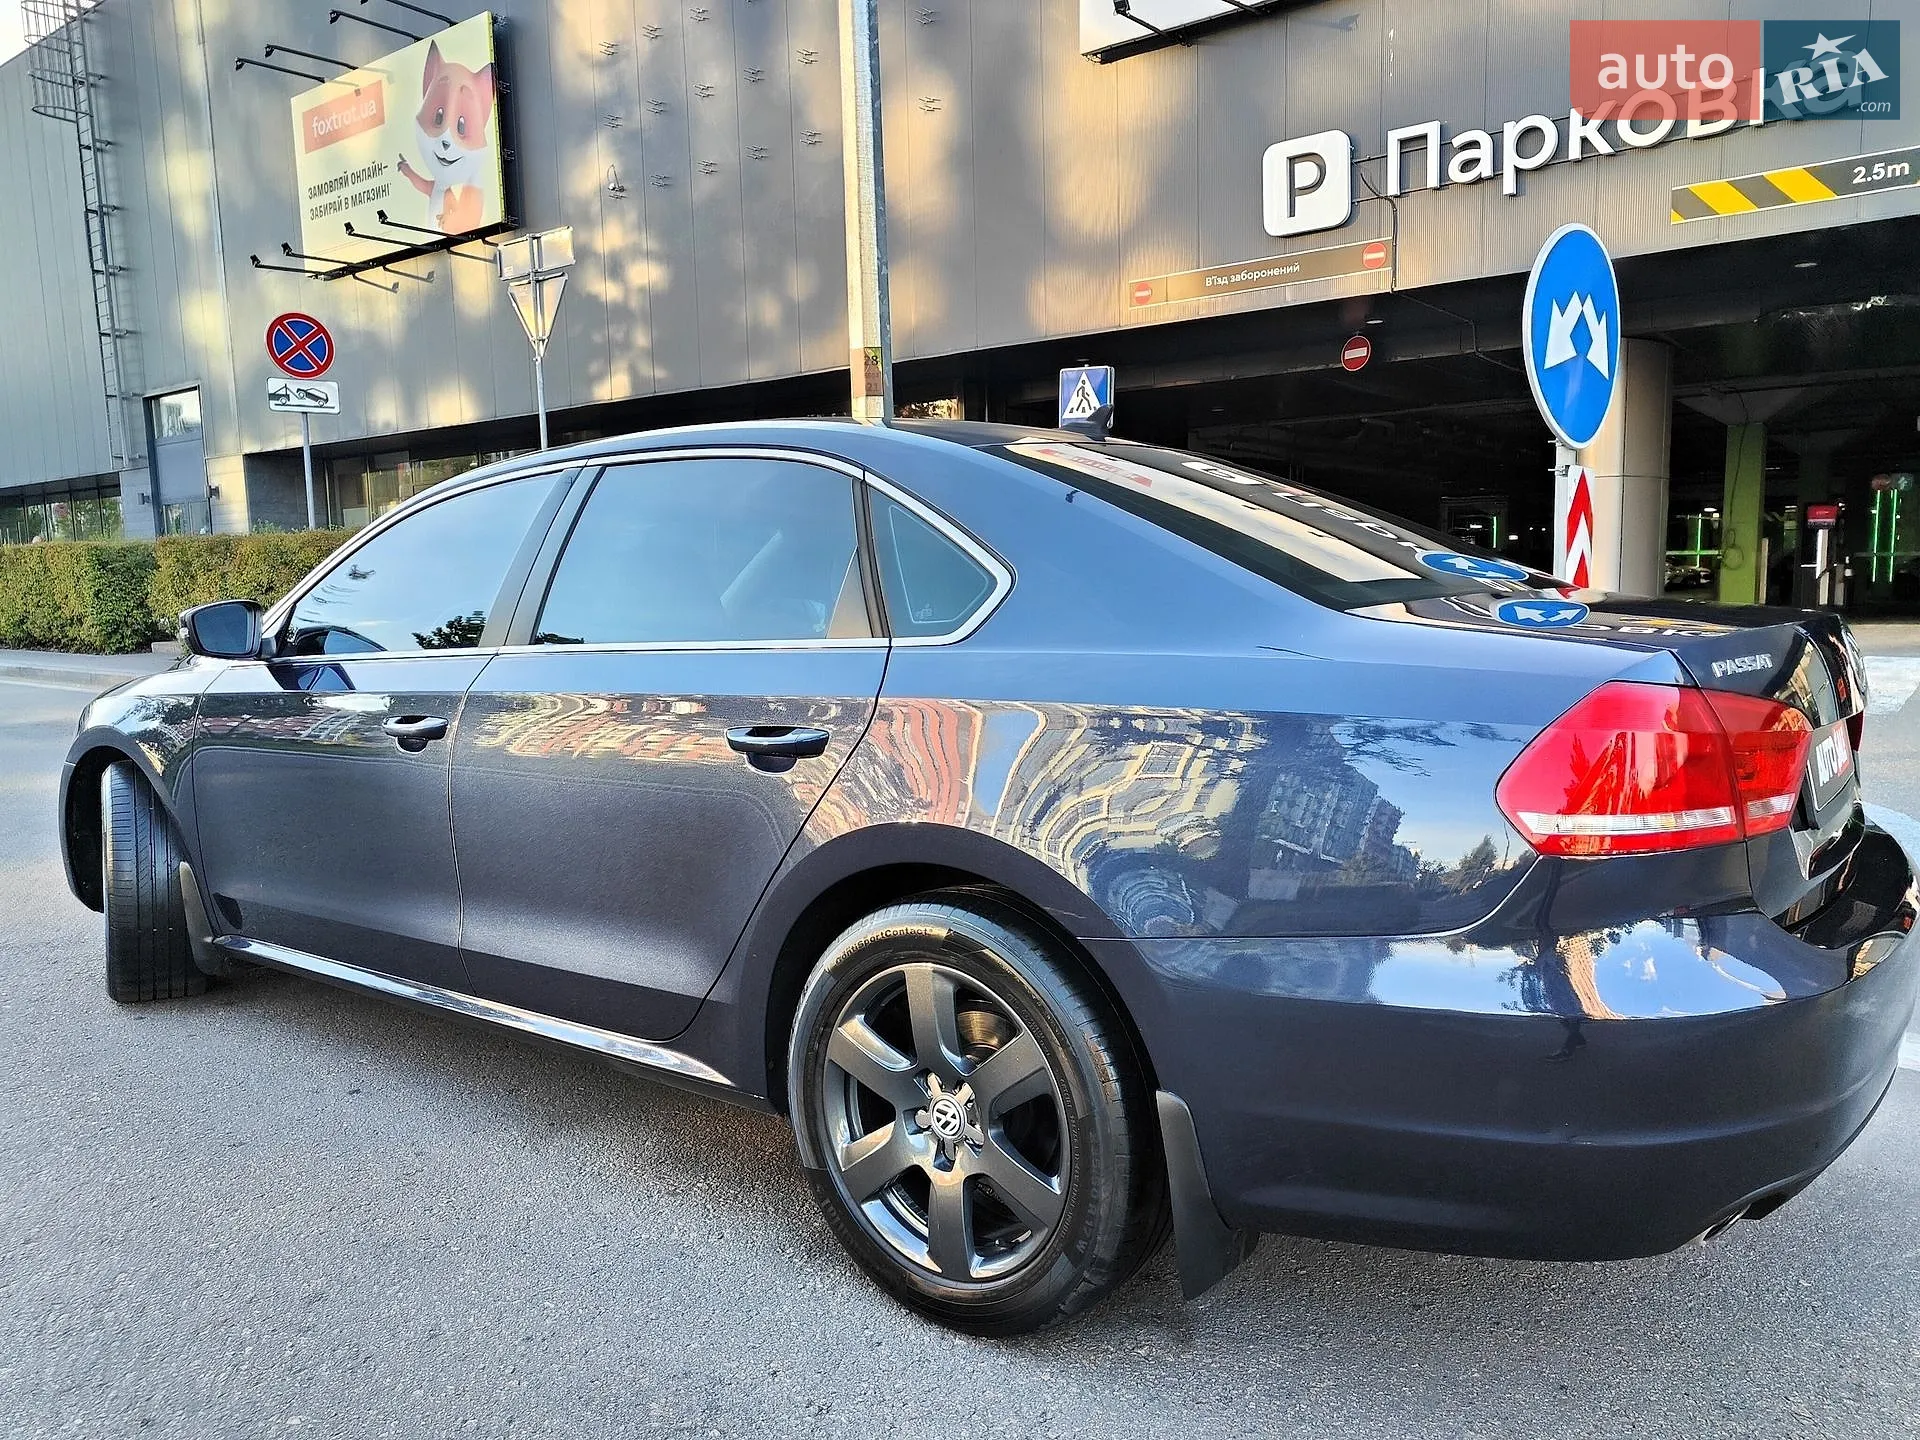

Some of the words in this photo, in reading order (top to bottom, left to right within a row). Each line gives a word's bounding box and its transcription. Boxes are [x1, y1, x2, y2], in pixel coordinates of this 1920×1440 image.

[311, 100, 377, 139] foxtrot.ua
[308, 171, 350, 200] ЗАМОВЛЯЙ
[1852, 161, 1911, 185] 2.5m
[310, 195, 343, 221] ЗАБИРАЙ
[344, 197, 350, 210] В
[1230, 262, 1301, 284] заборонений
[1711, 653, 1774, 678] PASSAT
[835, 926, 928, 966] ContiSportContact
